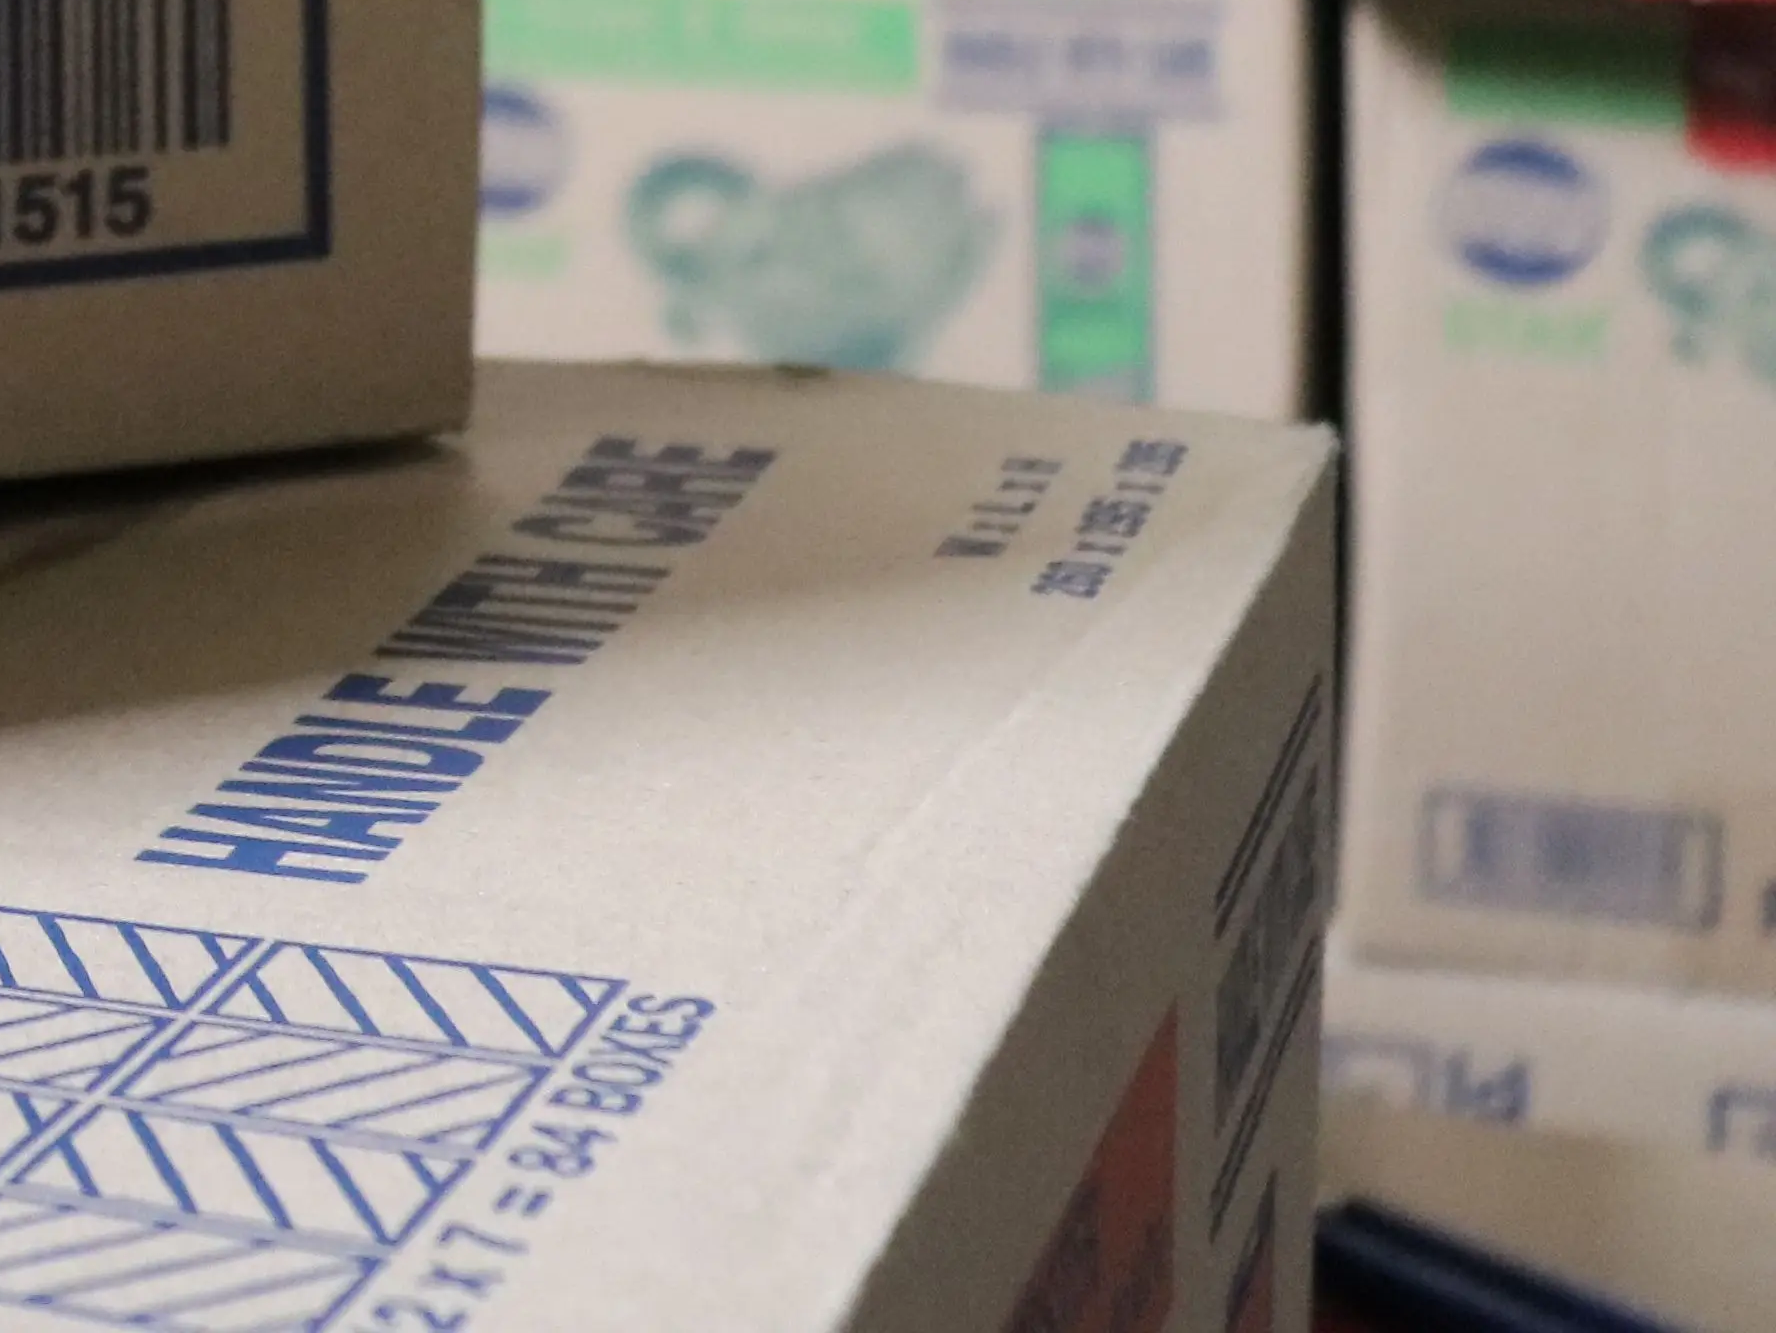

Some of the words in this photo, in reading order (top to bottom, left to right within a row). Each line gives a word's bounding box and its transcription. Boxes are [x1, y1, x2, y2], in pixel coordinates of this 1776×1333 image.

[510, 436, 778, 548] CARE
[372, 553, 672, 665] WITH
[133, 673, 553, 885] HANDLE
[545, 993, 717, 1118] BOXES
[506, 1121, 619, 1179] 84
[436, 1220, 531, 1256] 7
